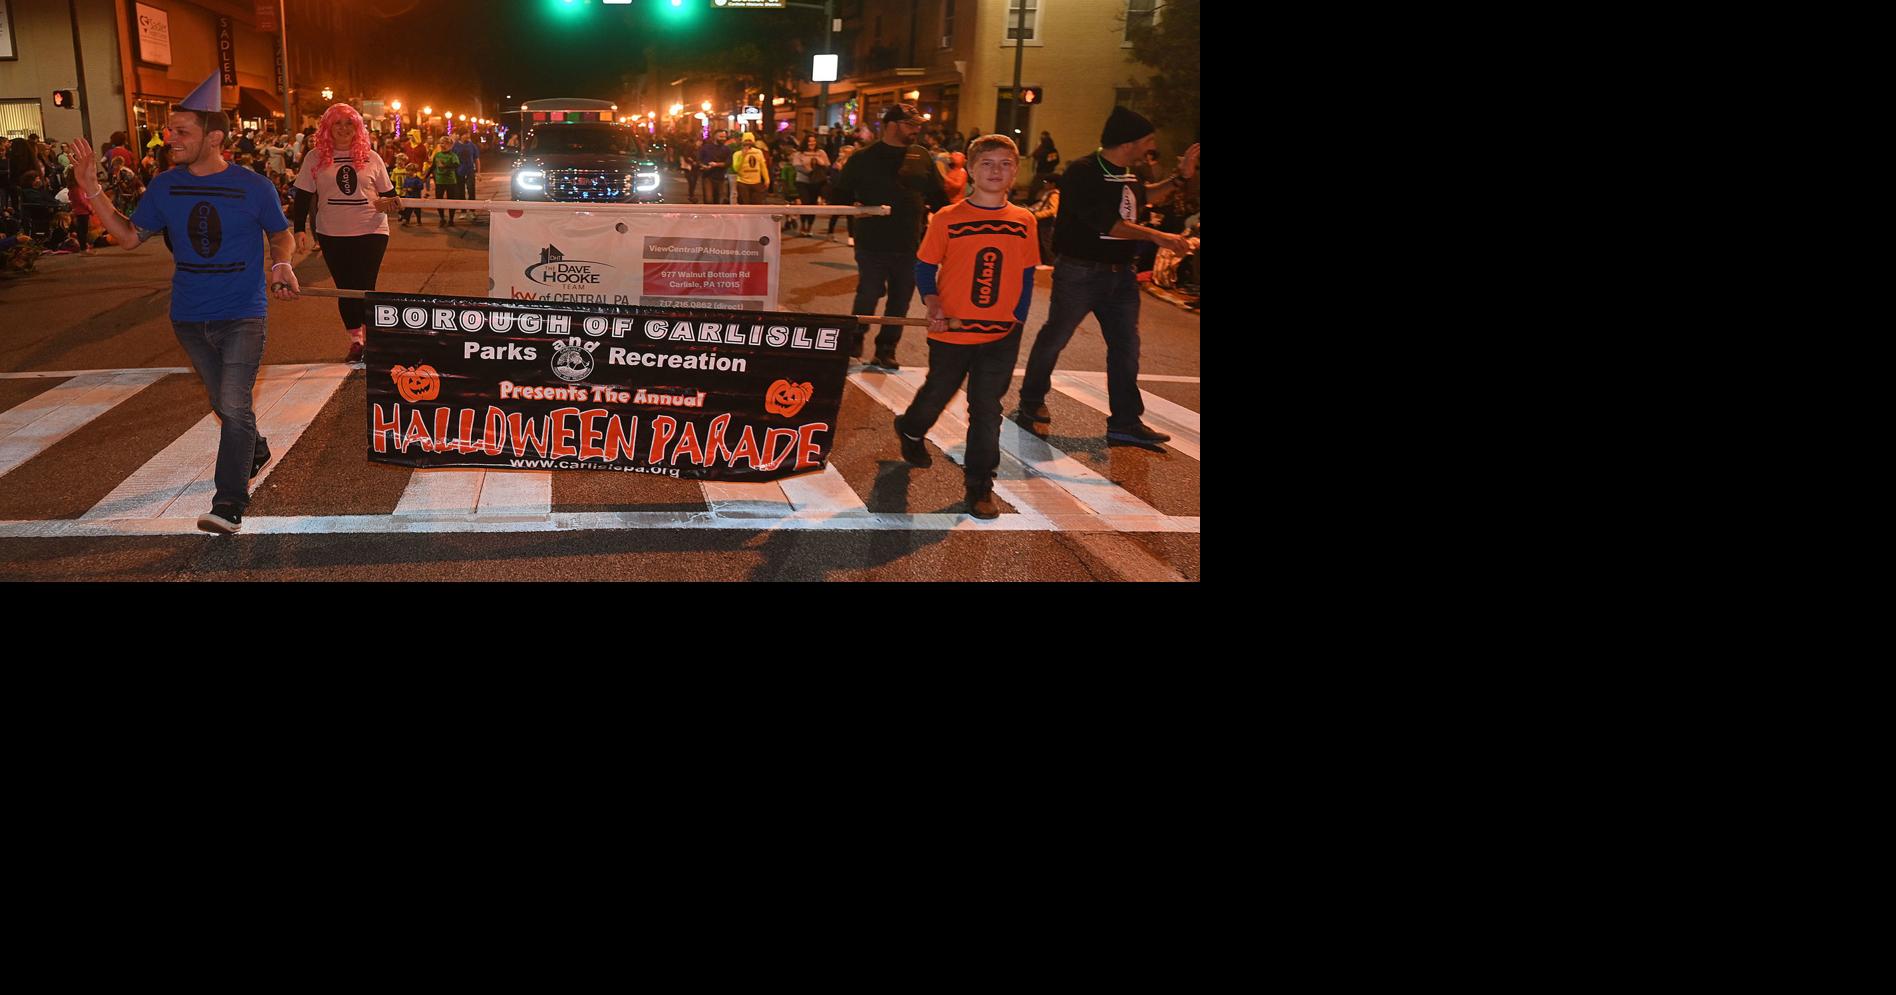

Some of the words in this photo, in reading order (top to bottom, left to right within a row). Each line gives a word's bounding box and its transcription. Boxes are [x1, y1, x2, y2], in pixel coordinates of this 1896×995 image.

[220, 18, 233, 83] SADLER
[342, 166, 351, 194] Crayon
[197, 205, 210, 258] Crayon
[649, 244, 759, 257] ViewCentralPAHouses.com
[543, 271, 600, 284] HOOKE
[558, 264, 591, 274] DAVE
[661, 271, 677, 279] 977
[678, 271, 706, 279] Walnut
[707, 271, 738, 279] Bottom
[739, 271, 750, 279] Rd
[976, 252, 997, 304] Crayon
[511, 286, 537, 302] kw
[539, 293, 550, 302] of
[553, 293, 608, 304] CENTRAL
[614, 294, 629, 305] PA
[669, 280, 700, 289] Carlisle,
[717, 281, 740, 289] 17015
[374, 304, 571, 334] BOROUGH
[583, 315, 634, 338] OF
[644, 318, 841, 351] CARLISLE
[464, 340, 538, 361] Parks
[551, 336, 601, 353] and
[608, 346, 747, 373] Recreation
[499, 380, 588, 402] Presents
[591, 384, 630, 404] The
[633, 388, 707, 408] Annual
[373, 402, 638, 463] HALLOWEEN
[648, 412, 829, 472] PARADE
[510, 458, 680, 479] www.carlislepa.org
